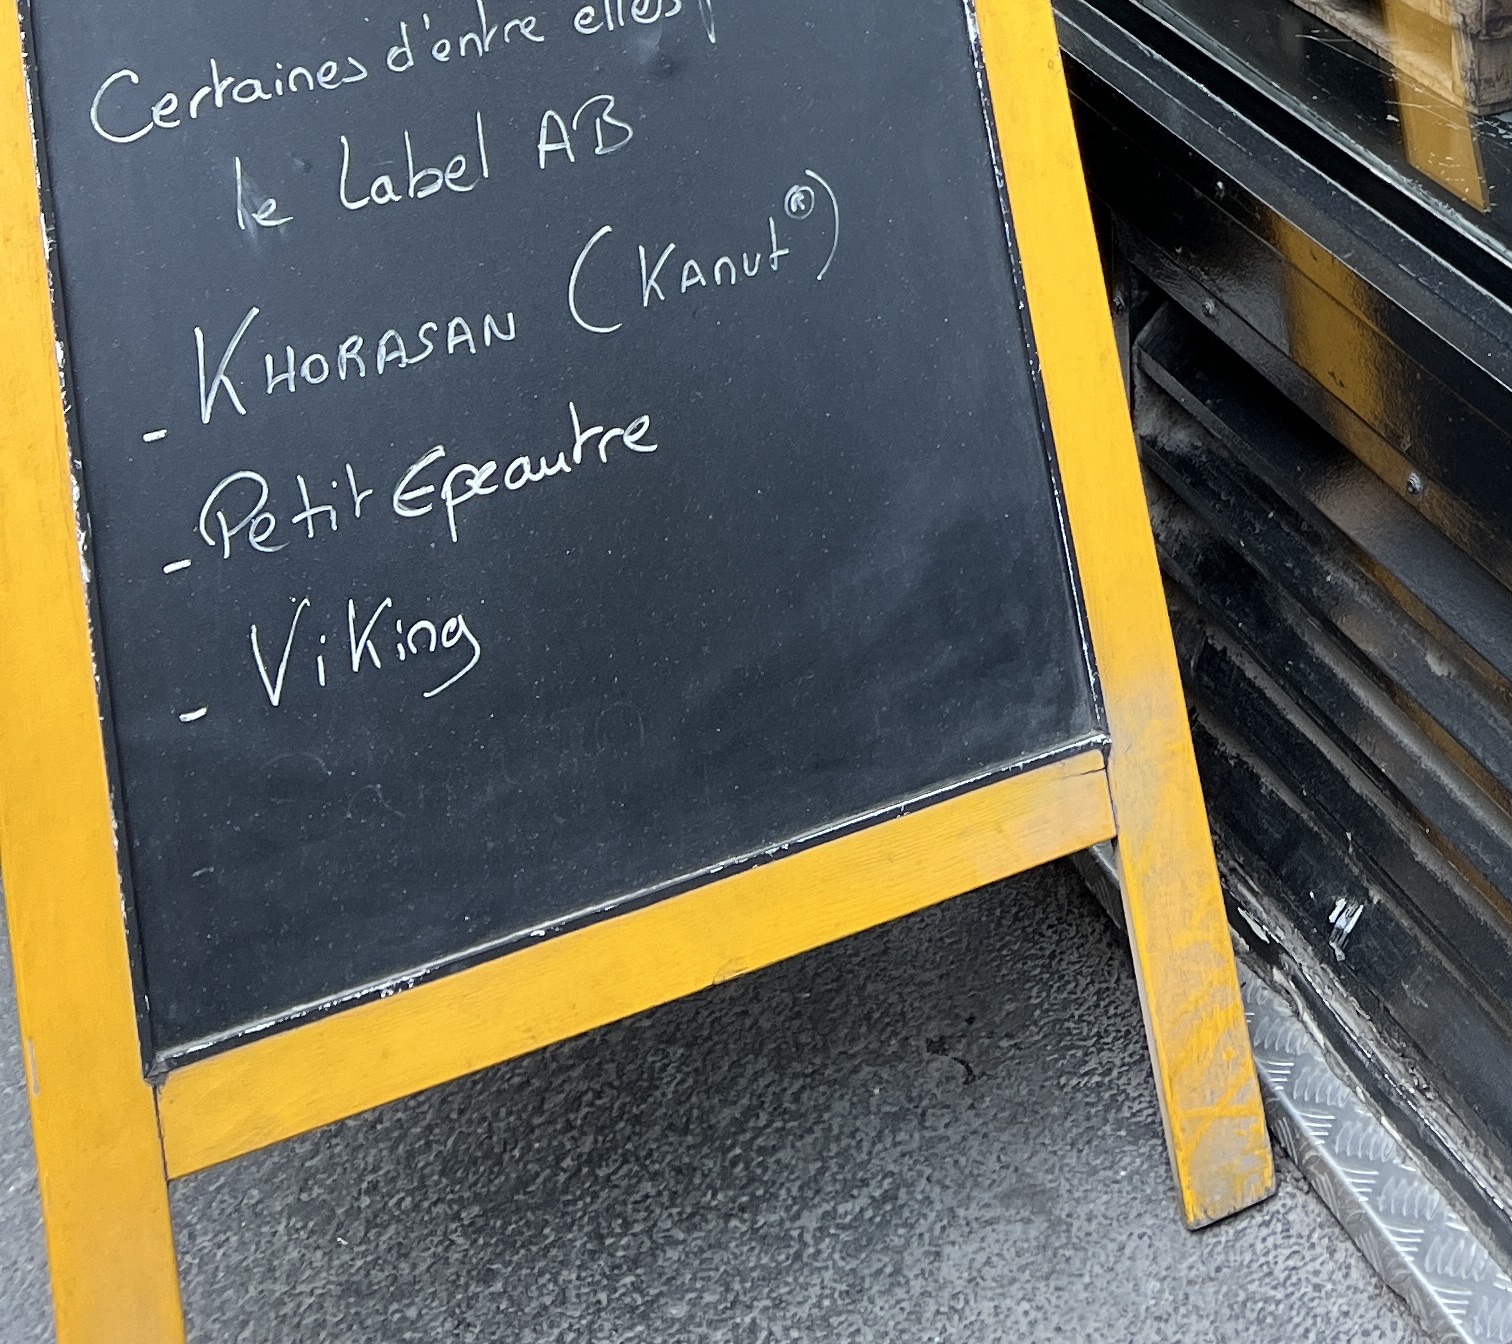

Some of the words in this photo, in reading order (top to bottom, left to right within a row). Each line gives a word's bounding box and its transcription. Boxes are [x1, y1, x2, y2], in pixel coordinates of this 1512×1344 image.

[89, 48, 371, 144] Certaines
[234, 157, 294, 229] le
[339, 111, 491, 211] Label
[535, 90, 636, 171] AB
[194, 305, 518, 425] KHORASAN
[198, 464, 376, 559] Petit
